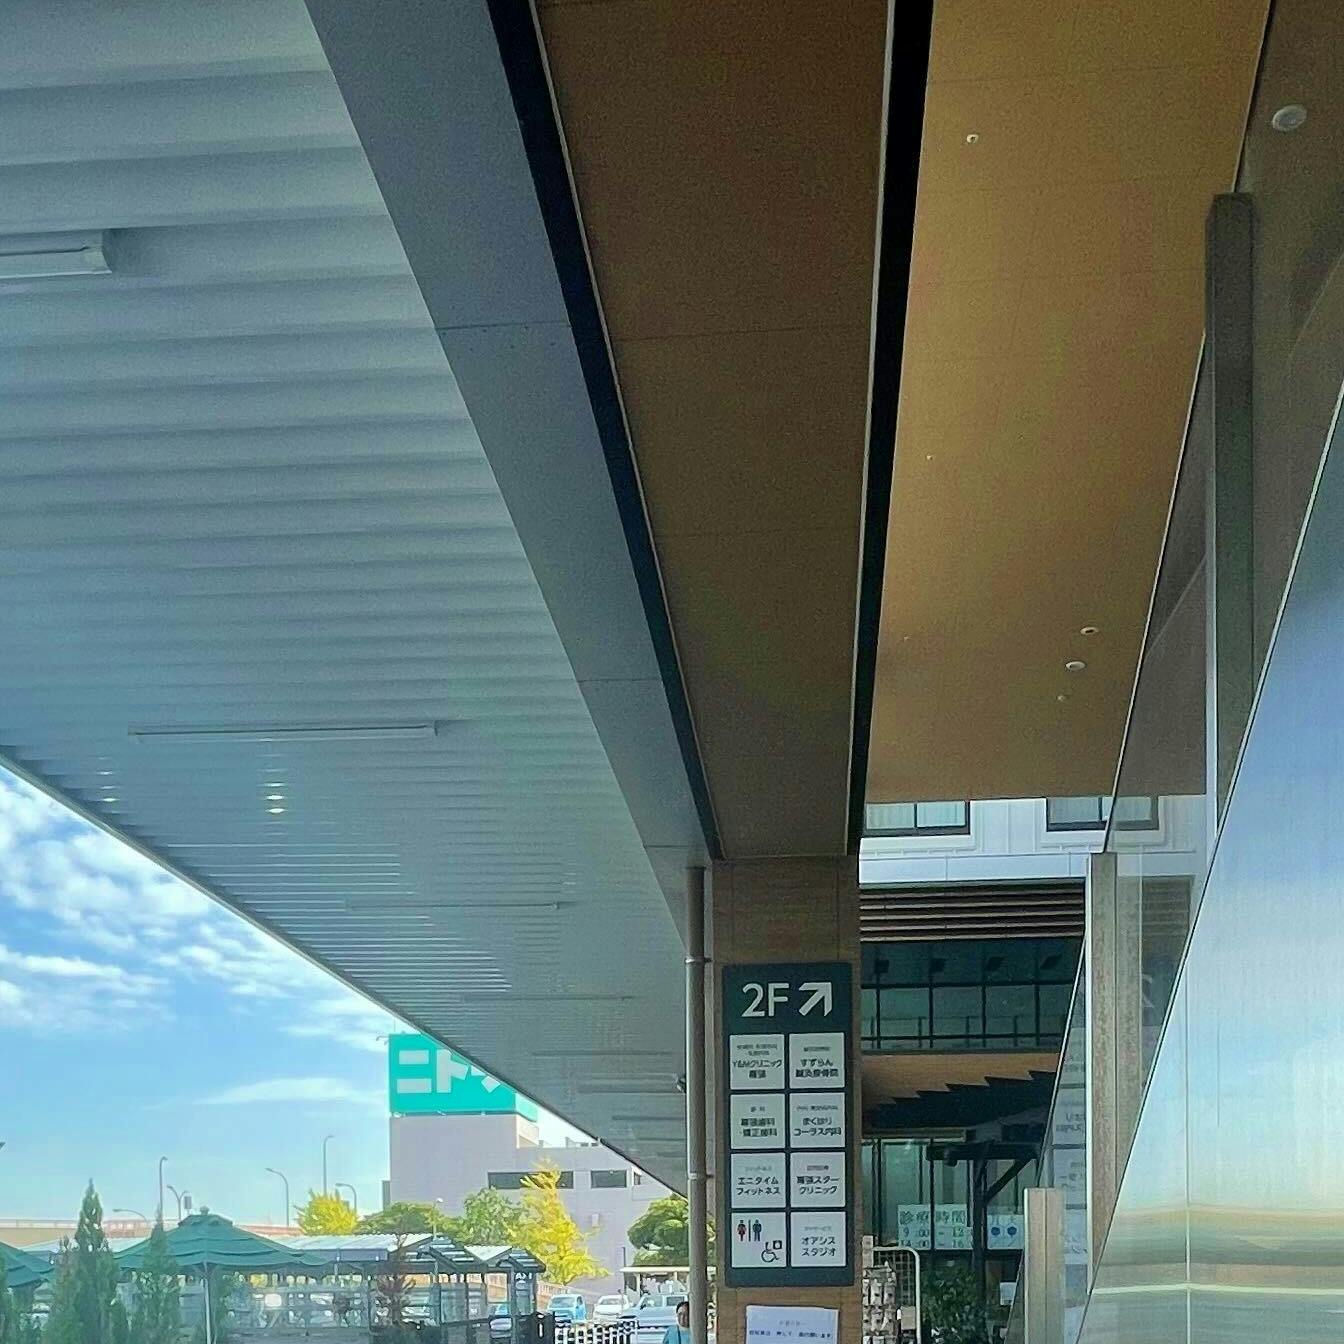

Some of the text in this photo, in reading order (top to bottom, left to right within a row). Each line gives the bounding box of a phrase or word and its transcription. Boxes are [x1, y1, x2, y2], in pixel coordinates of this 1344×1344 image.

[741, 983, 789, 1017] 2F
[800, 1059, 834, 1067] すずらん
[737, 1176, 779, 1185] エニタイム
[736, 1187, 780, 1195] フィットネス
[799, 1186, 838, 1195] クリニック
[801, 1236, 836, 1245] オアシス
[801, 1247, 837, 1257] スタジオ
